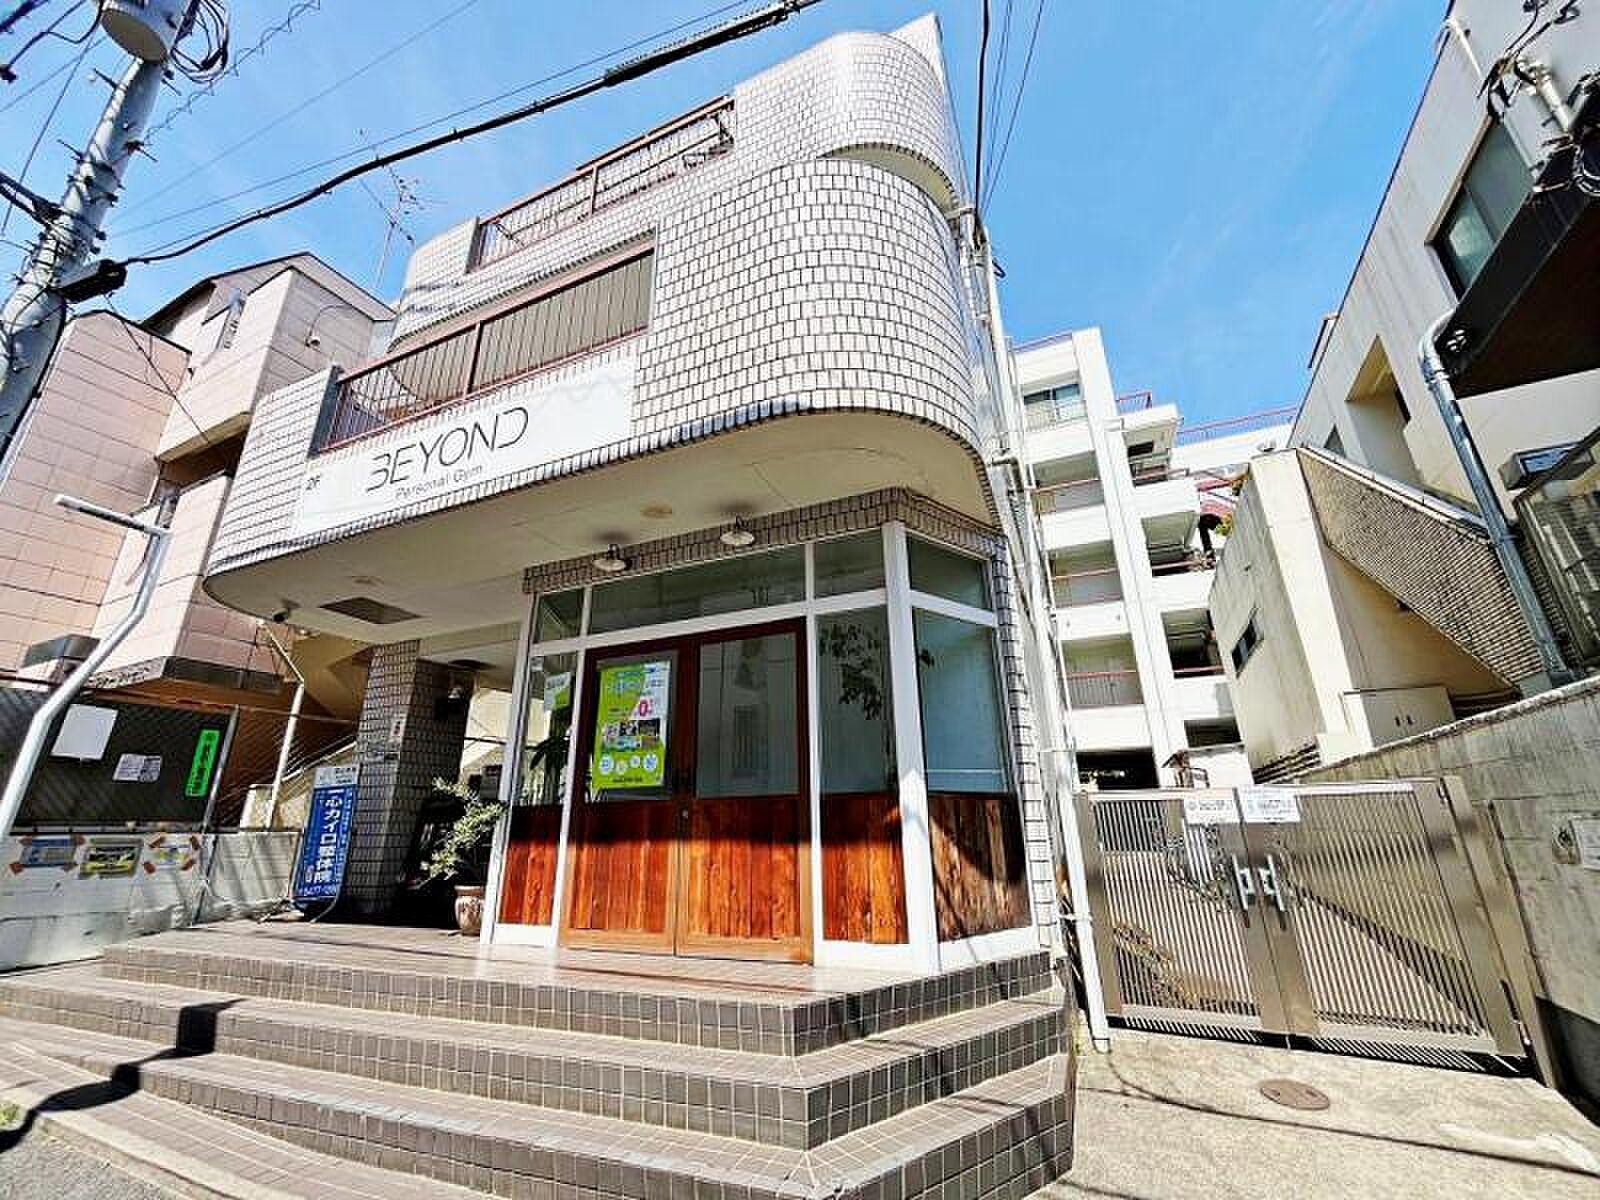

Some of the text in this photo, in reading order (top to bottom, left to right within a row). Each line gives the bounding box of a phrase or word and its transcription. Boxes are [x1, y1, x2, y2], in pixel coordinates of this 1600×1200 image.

[366, 406, 529, 492] BEYOND
[396, 464, 483, 498] Personal Gym
